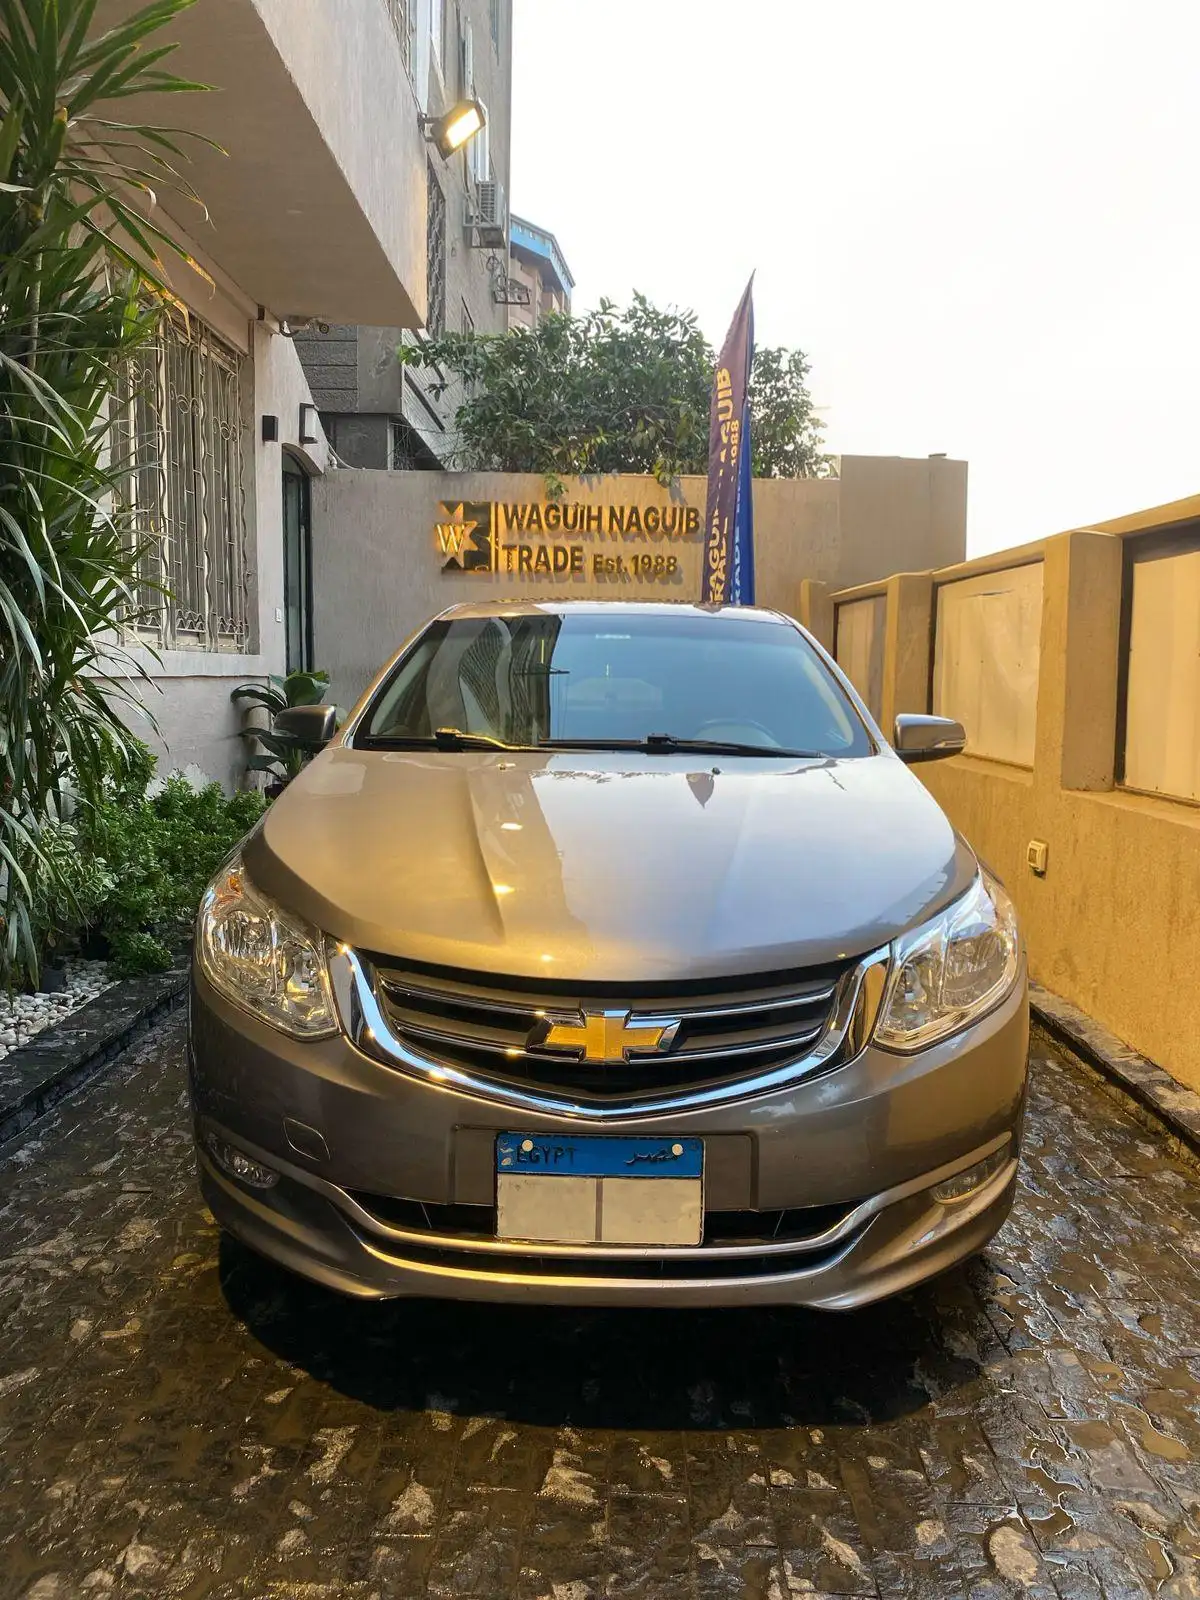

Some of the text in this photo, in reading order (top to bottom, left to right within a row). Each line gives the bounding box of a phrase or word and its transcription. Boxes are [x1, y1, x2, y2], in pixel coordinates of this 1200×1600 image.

[502, 503, 700, 534] WAGUIH NAGUIB
[502, 544, 678, 575] TRADE Est. 1988
